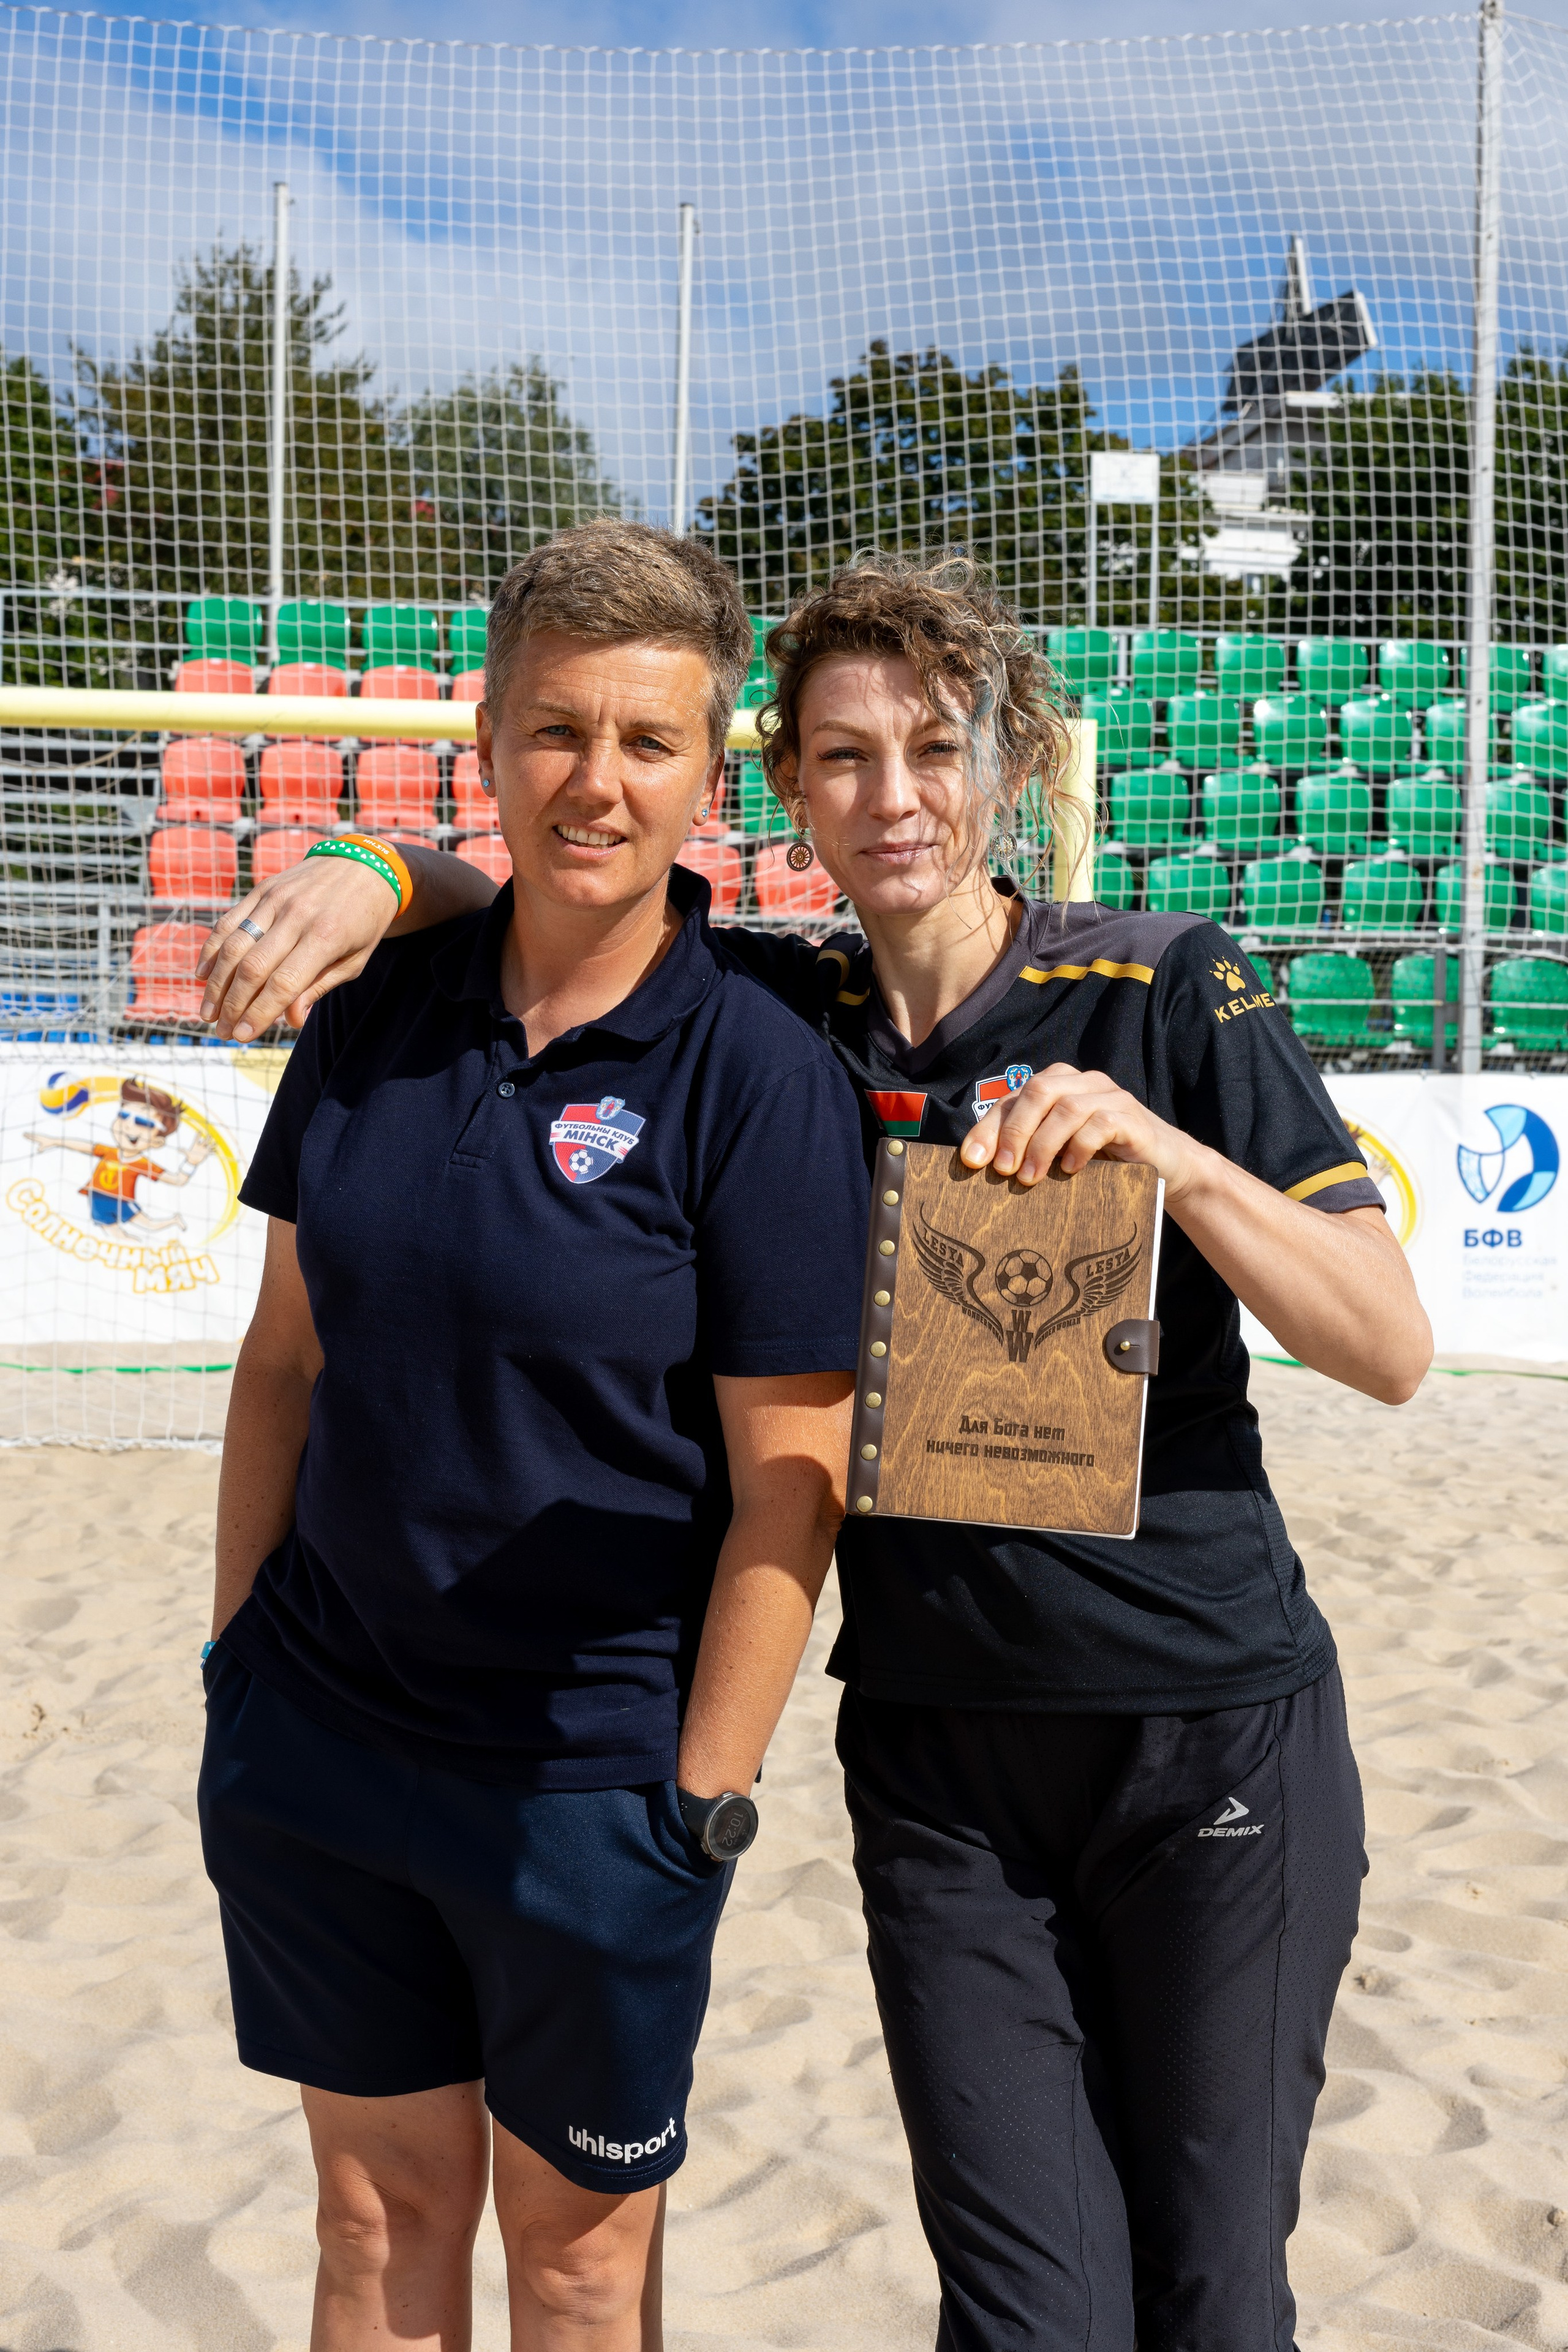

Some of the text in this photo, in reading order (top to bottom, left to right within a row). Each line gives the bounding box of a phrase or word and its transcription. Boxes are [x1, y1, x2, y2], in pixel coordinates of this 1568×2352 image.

[1214, 992, 1275, 1023] KELME
[555, 1123, 635, 1145] ФУТБОЛЬНЫ КЛУБ
[564, 1129, 619, 1152] МІНСК
[923, 1227, 963, 1268] LESYA
[1464, 1229, 1523, 1248] БФВ
[1085, 1248, 1131, 1278] LESYA
[959, 1415, 1065, 1441] Для Бога нет
[926, 1439, 1095, 1467] ничего невозможного
[722, 1812, 744, 1846] 10:22
[1197, 1824, 1265, 1837] DEMIX
[568, 2117, 676, 2164] uhlsport
